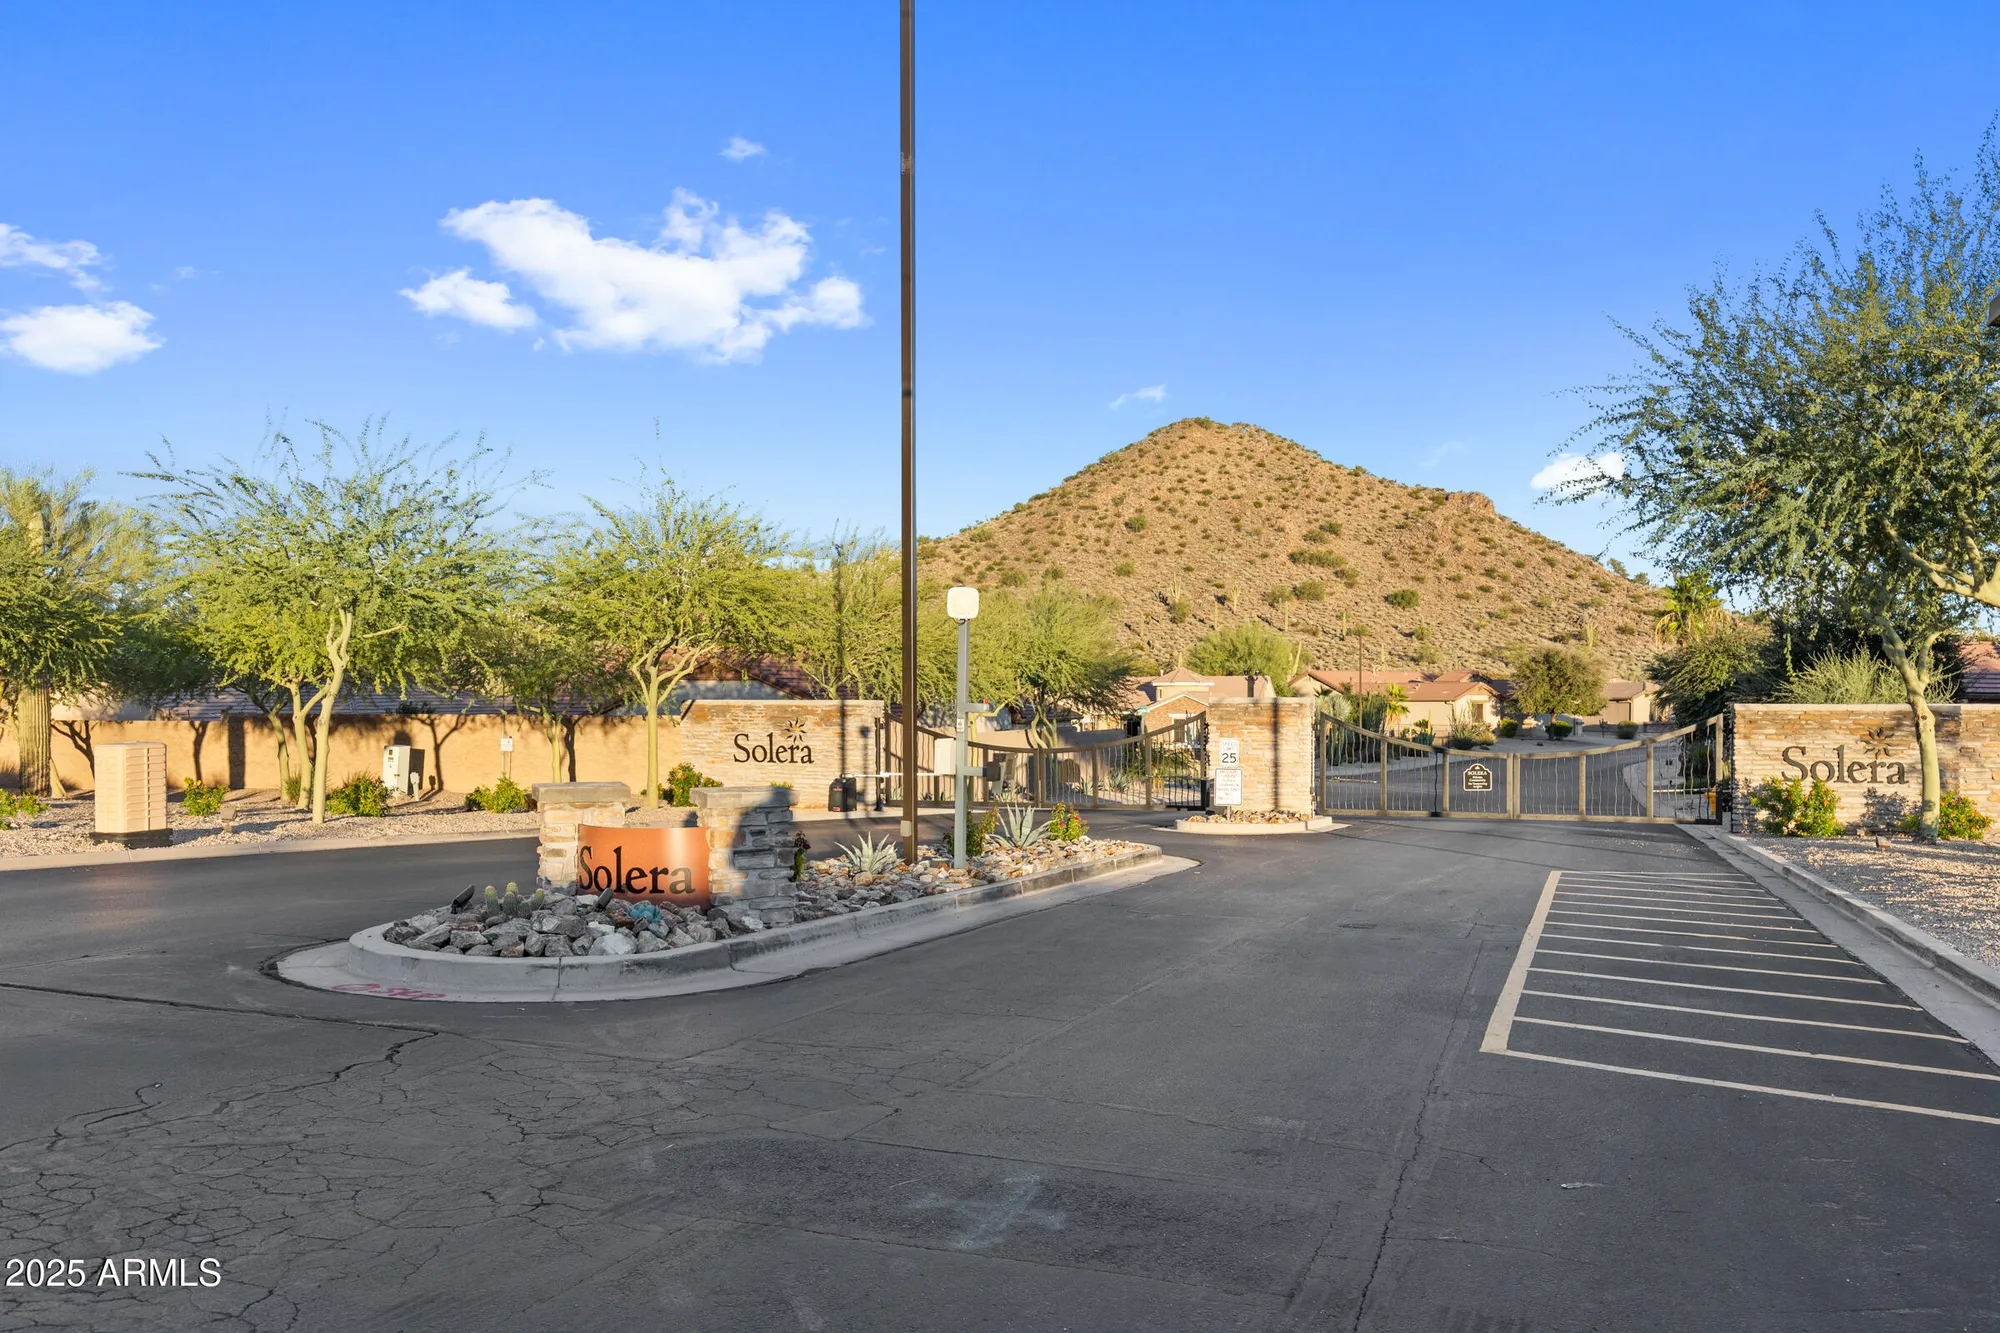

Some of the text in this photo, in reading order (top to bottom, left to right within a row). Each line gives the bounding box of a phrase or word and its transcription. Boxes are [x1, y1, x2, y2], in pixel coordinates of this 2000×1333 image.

[733, 732, 815, 764] Solera
[1221, 752, 1237, 764] 25
[1781, 744, 1910, 785] Solera
[578, 845, 696, 895] Solera
